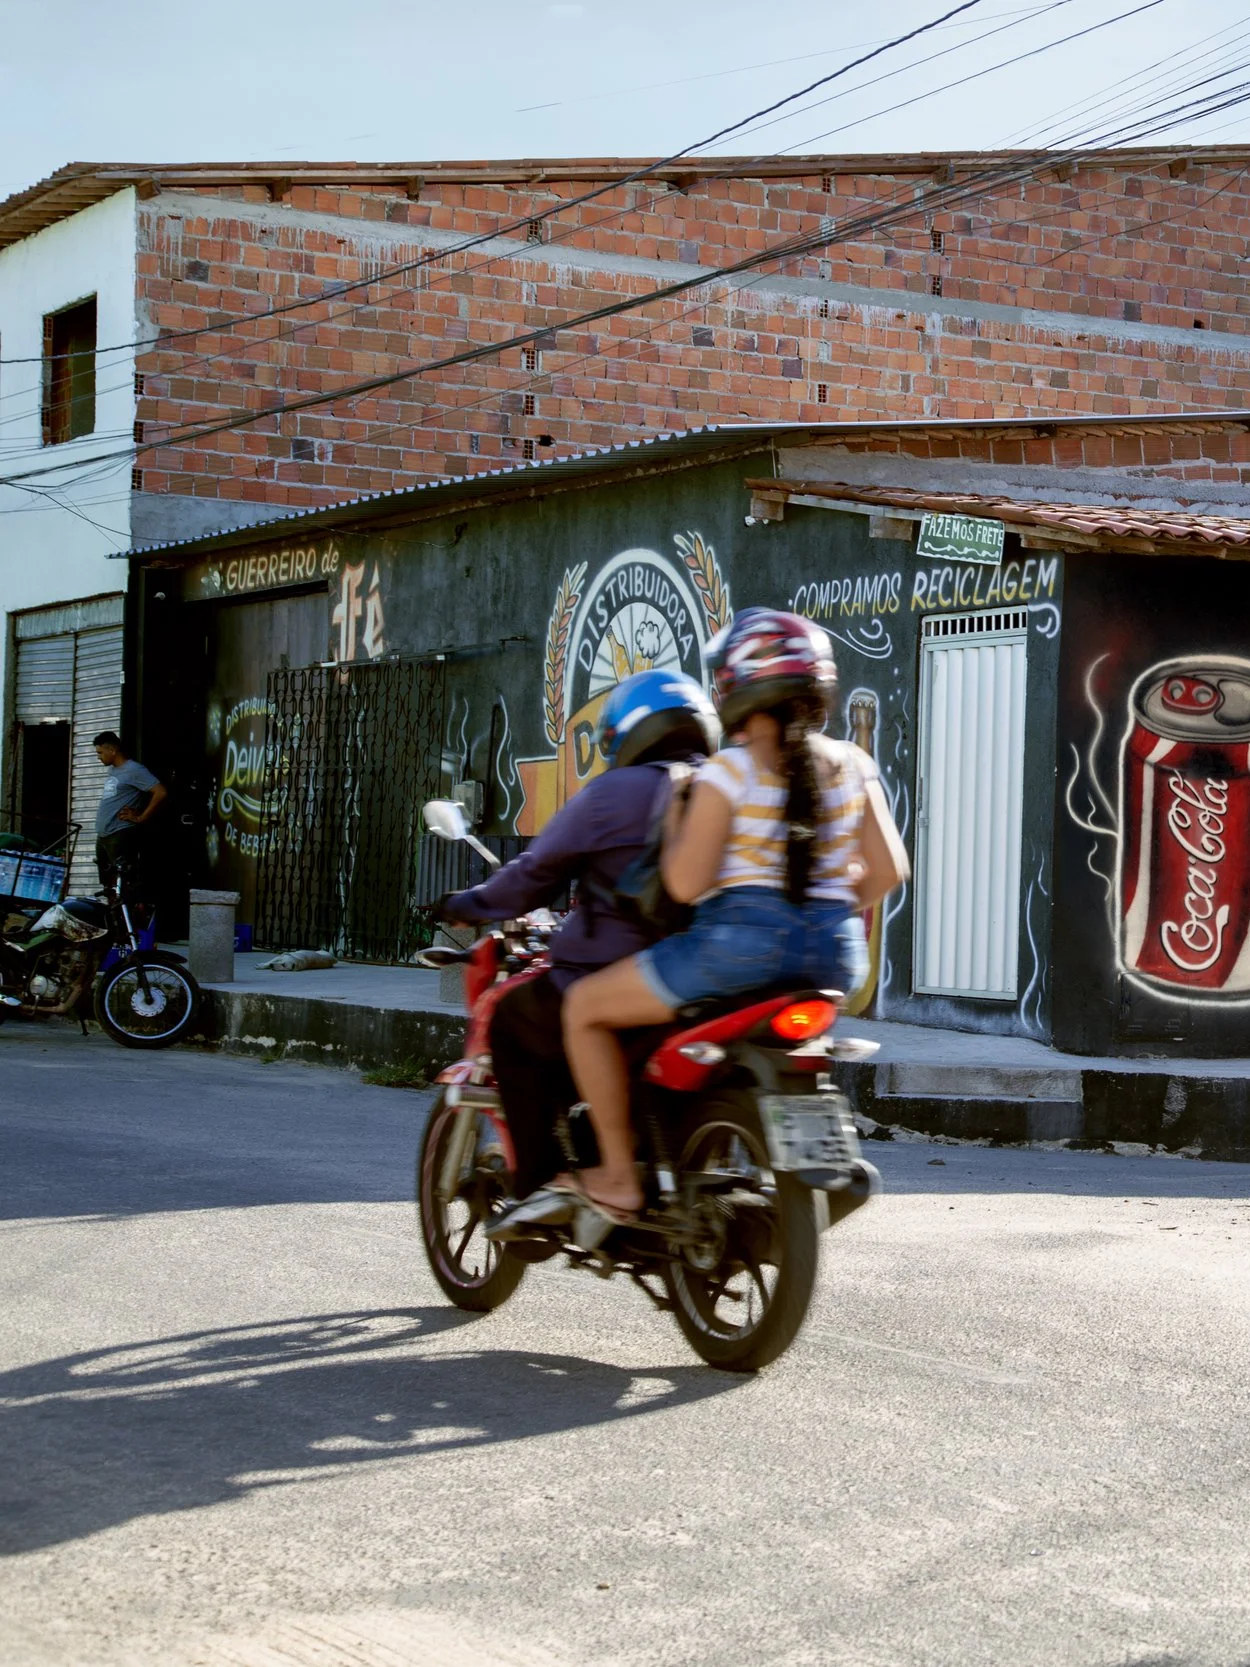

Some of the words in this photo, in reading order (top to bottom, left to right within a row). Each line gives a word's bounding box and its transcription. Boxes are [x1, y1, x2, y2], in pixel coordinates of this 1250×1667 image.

[921, 515, 974, 542] FAZEMOS
[976, 524, 1004, 547] FRETE
[226, 548, 317, 590] GUERREIRO
[321, 541, 339, 574] de
[793, 572, 902, 620] COMPRAMOS
[910, 557, 1059, 613] RECICLAGEM
[578, 563, 694, 673] DISTRIBUIDORA
[225, 822, 237, 847] DE
